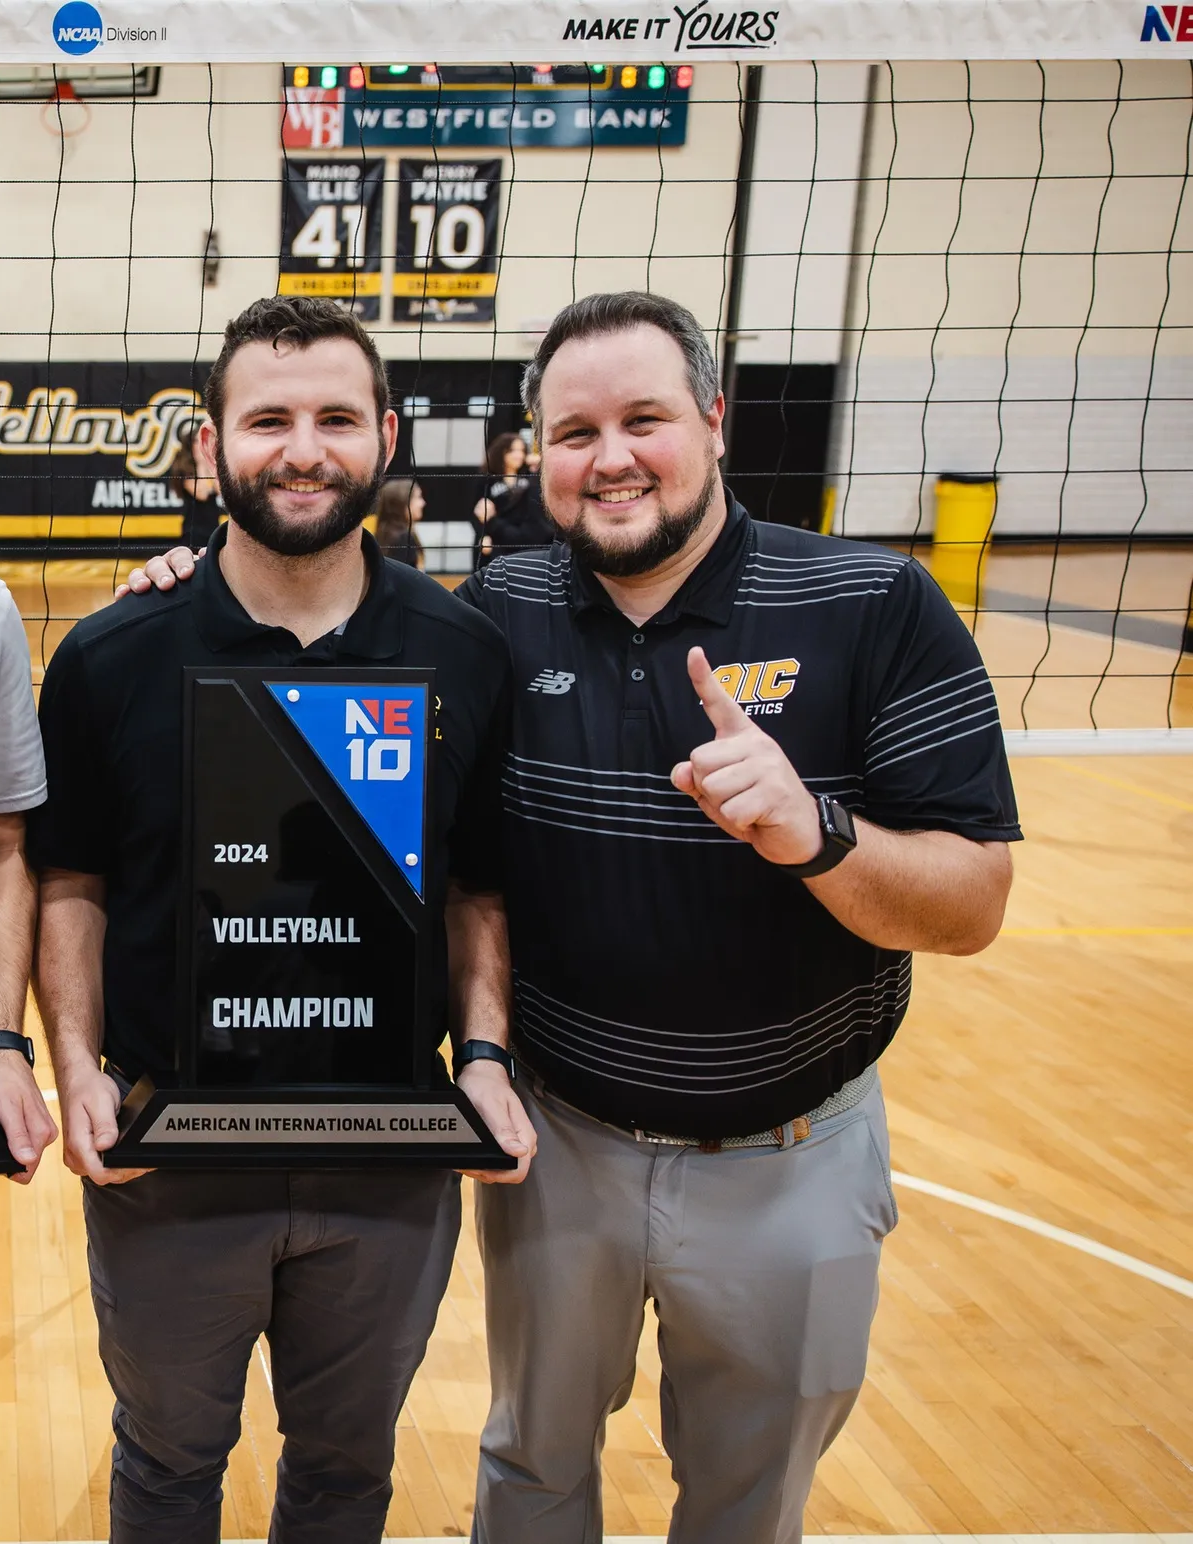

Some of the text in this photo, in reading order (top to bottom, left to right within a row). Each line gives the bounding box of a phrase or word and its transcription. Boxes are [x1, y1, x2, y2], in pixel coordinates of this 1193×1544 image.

[57, 27, 101, 42] NCAA
[106, 27, 167, 41] Division II
[562, 18, 639, 40] MAKE
[643, 18, 670, 40] IT
[353, 107, 672, 129] WESTFIELD BANK
[306, 165, 361, 180] MARIO
[422, 164, 479, 180] HENRY
[308, 181, 360, 201] ELIE
[411, 181, 488, 201] PAYNE
[292, 204, 367, 268] 41
[410, 204, 486, 269] 10
[702, 658, 801, 703] AIC
[345, 699, 414, 734] NE
[744, 702, 784, 716] ETICS
[345, 738, 411, 780] 10
[214, 844, 268, 863] 2024
[212, 917, 361, 943] VOLLEYBALL
[212, 997, 374, 1028] CHAMPION
[165, 1117, 457, 1132] AMERICAN INTERNATIONAL COLLEGE
